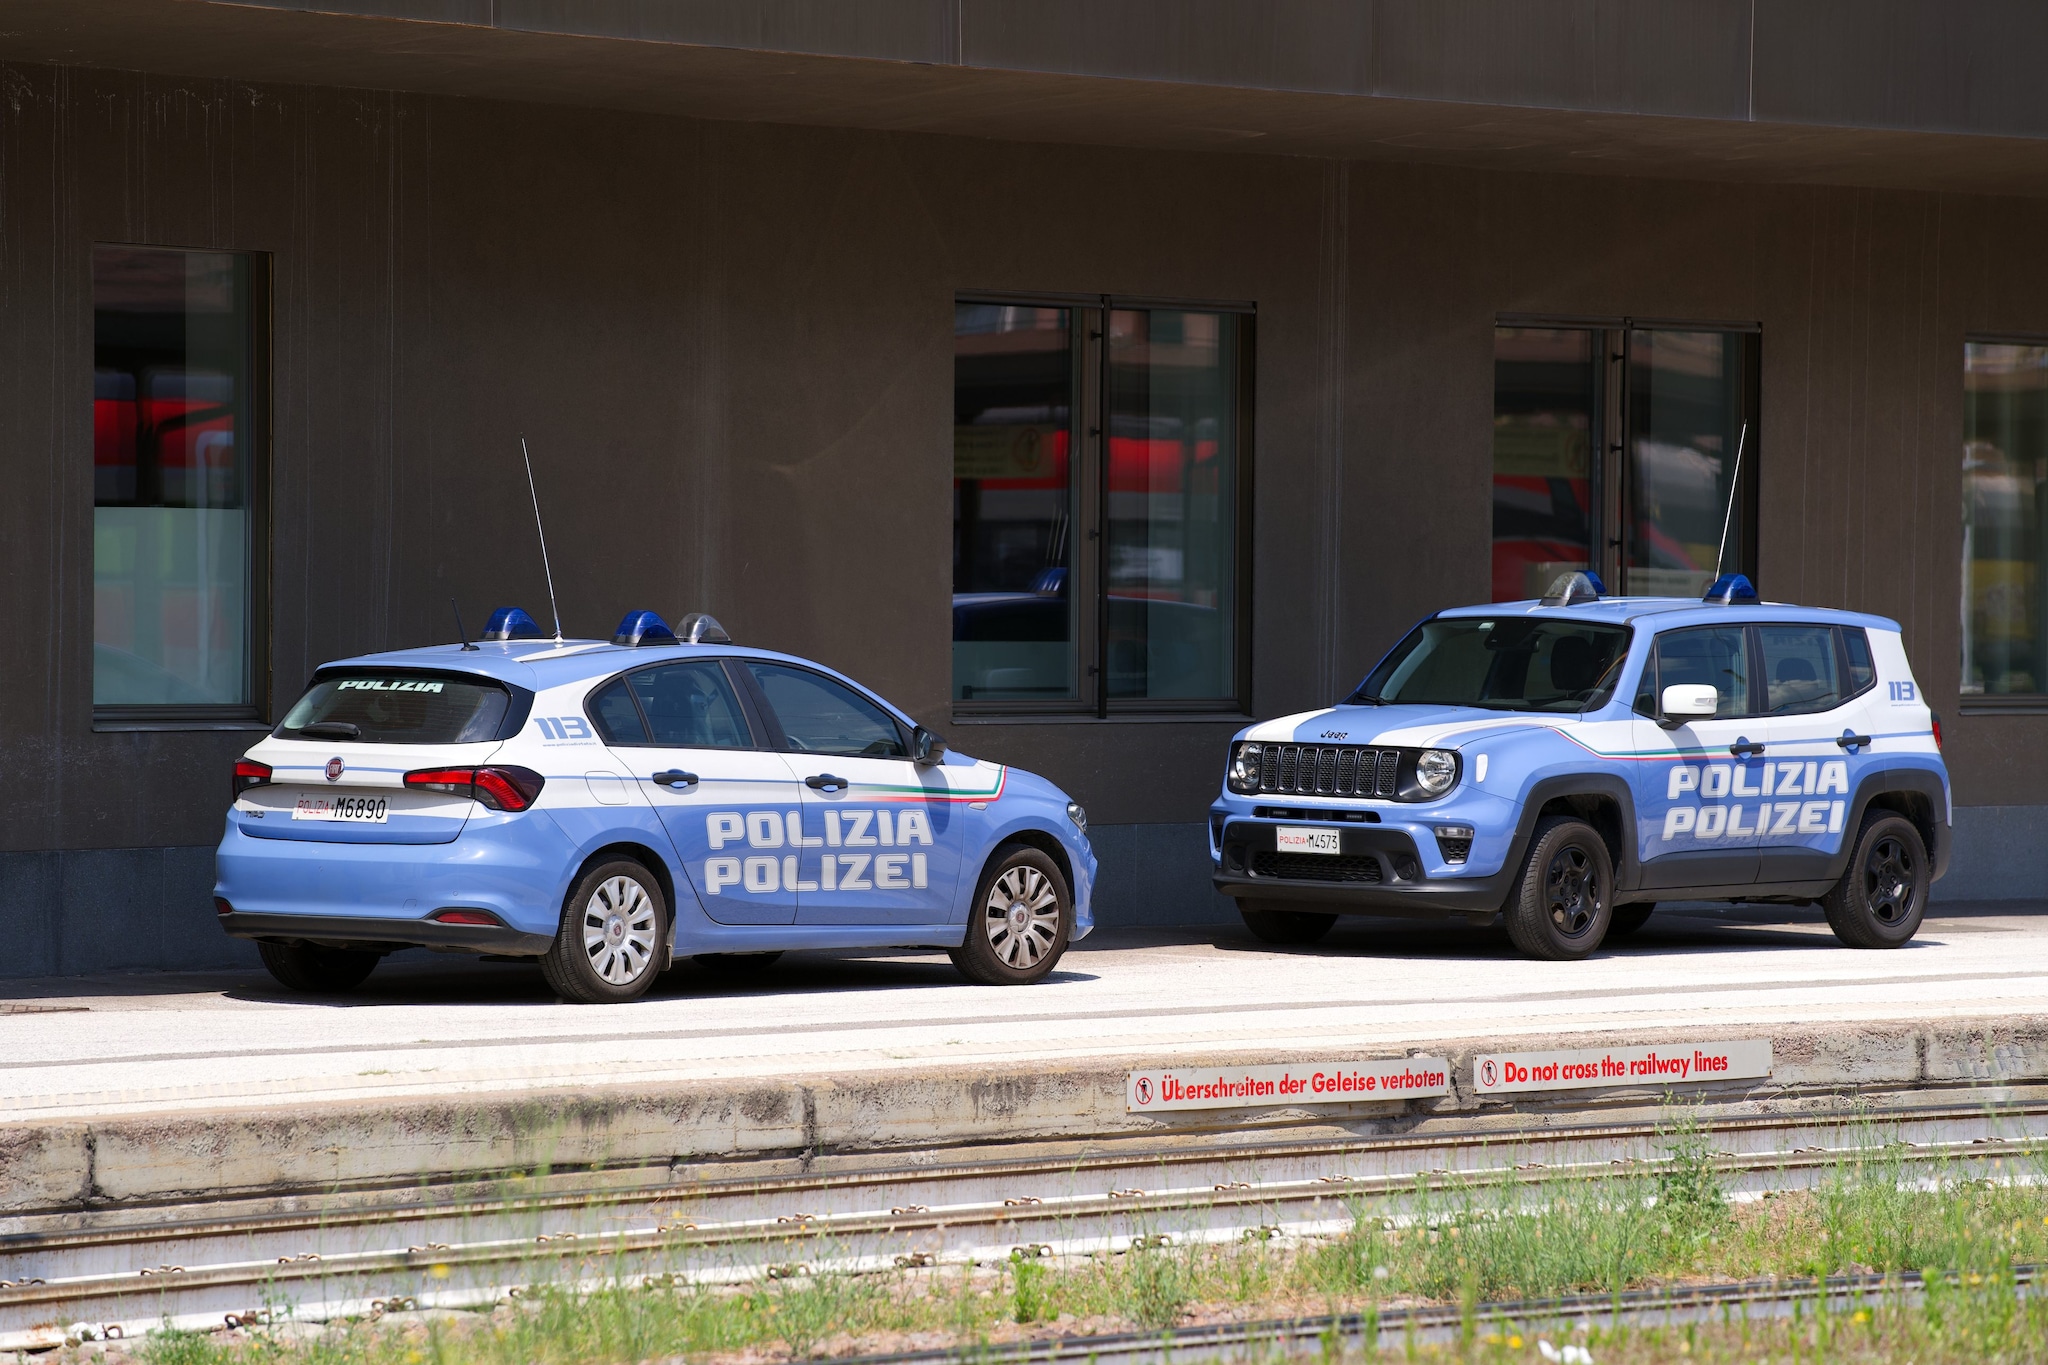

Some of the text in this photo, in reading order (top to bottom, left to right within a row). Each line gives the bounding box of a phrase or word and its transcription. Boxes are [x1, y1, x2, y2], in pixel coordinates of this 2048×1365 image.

[338, 680, 444, 693] POLIZIA
[1888, 681, 1915, 701] 113
[533, 716, 592, 740] 113
[1320, 730, 1348, 741] Jeep
[1667, 760, 1849, 800] POLIZIA
[297, 797, 386, 819] POLIZIA M6890
[1661, 800, 1846, 841] POLIZEI
[705, 809, 934, 850] POLIZIA
[1279, 834, 1338, 850] POLIZIA M4573
[704, 852, 929, 895] POLIZEI
[1504, 1050, 1728, 1083] Do not cross the railway lines
[1161, 1068, 1445, 1101] Überschreiten der Geleise verboten
